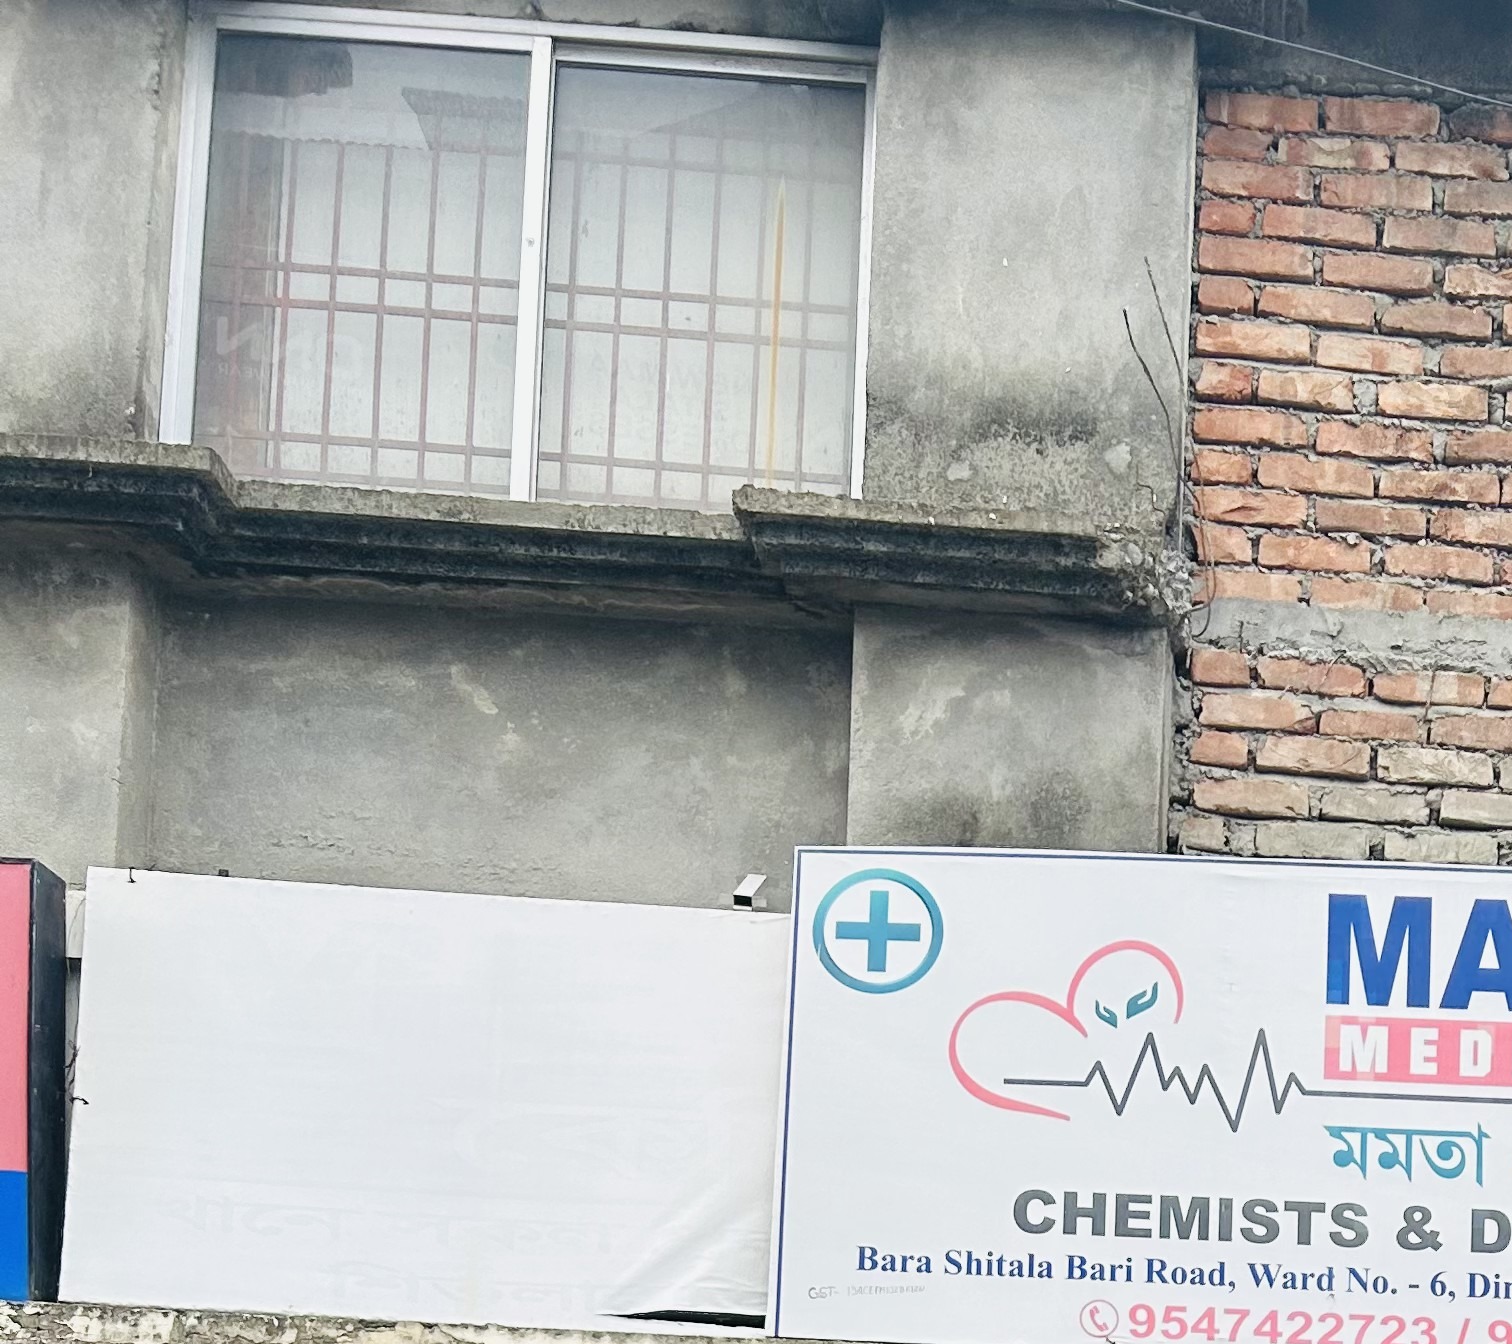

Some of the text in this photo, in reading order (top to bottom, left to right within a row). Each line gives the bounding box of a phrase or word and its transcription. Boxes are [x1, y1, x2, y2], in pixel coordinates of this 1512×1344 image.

[1323, 1122, 1490, 1187] মমতা
[1013, 1189, 1369, 1248] CHEMISTS
[1396, 1205, 1443, 1252] &
[857, 1245, 932, 1274] Bara
[944, 1249, 1053, 1279] Shitala
[1067, 1254, 1133, 1282] Bari
[1145, 1257, 1237, 1291] Road,
[1247, 1263, 1335, 1292] Ward
[1346, 1267, 1398, 1296] No.
[1429, 1272, 1455, 1303] 6,
